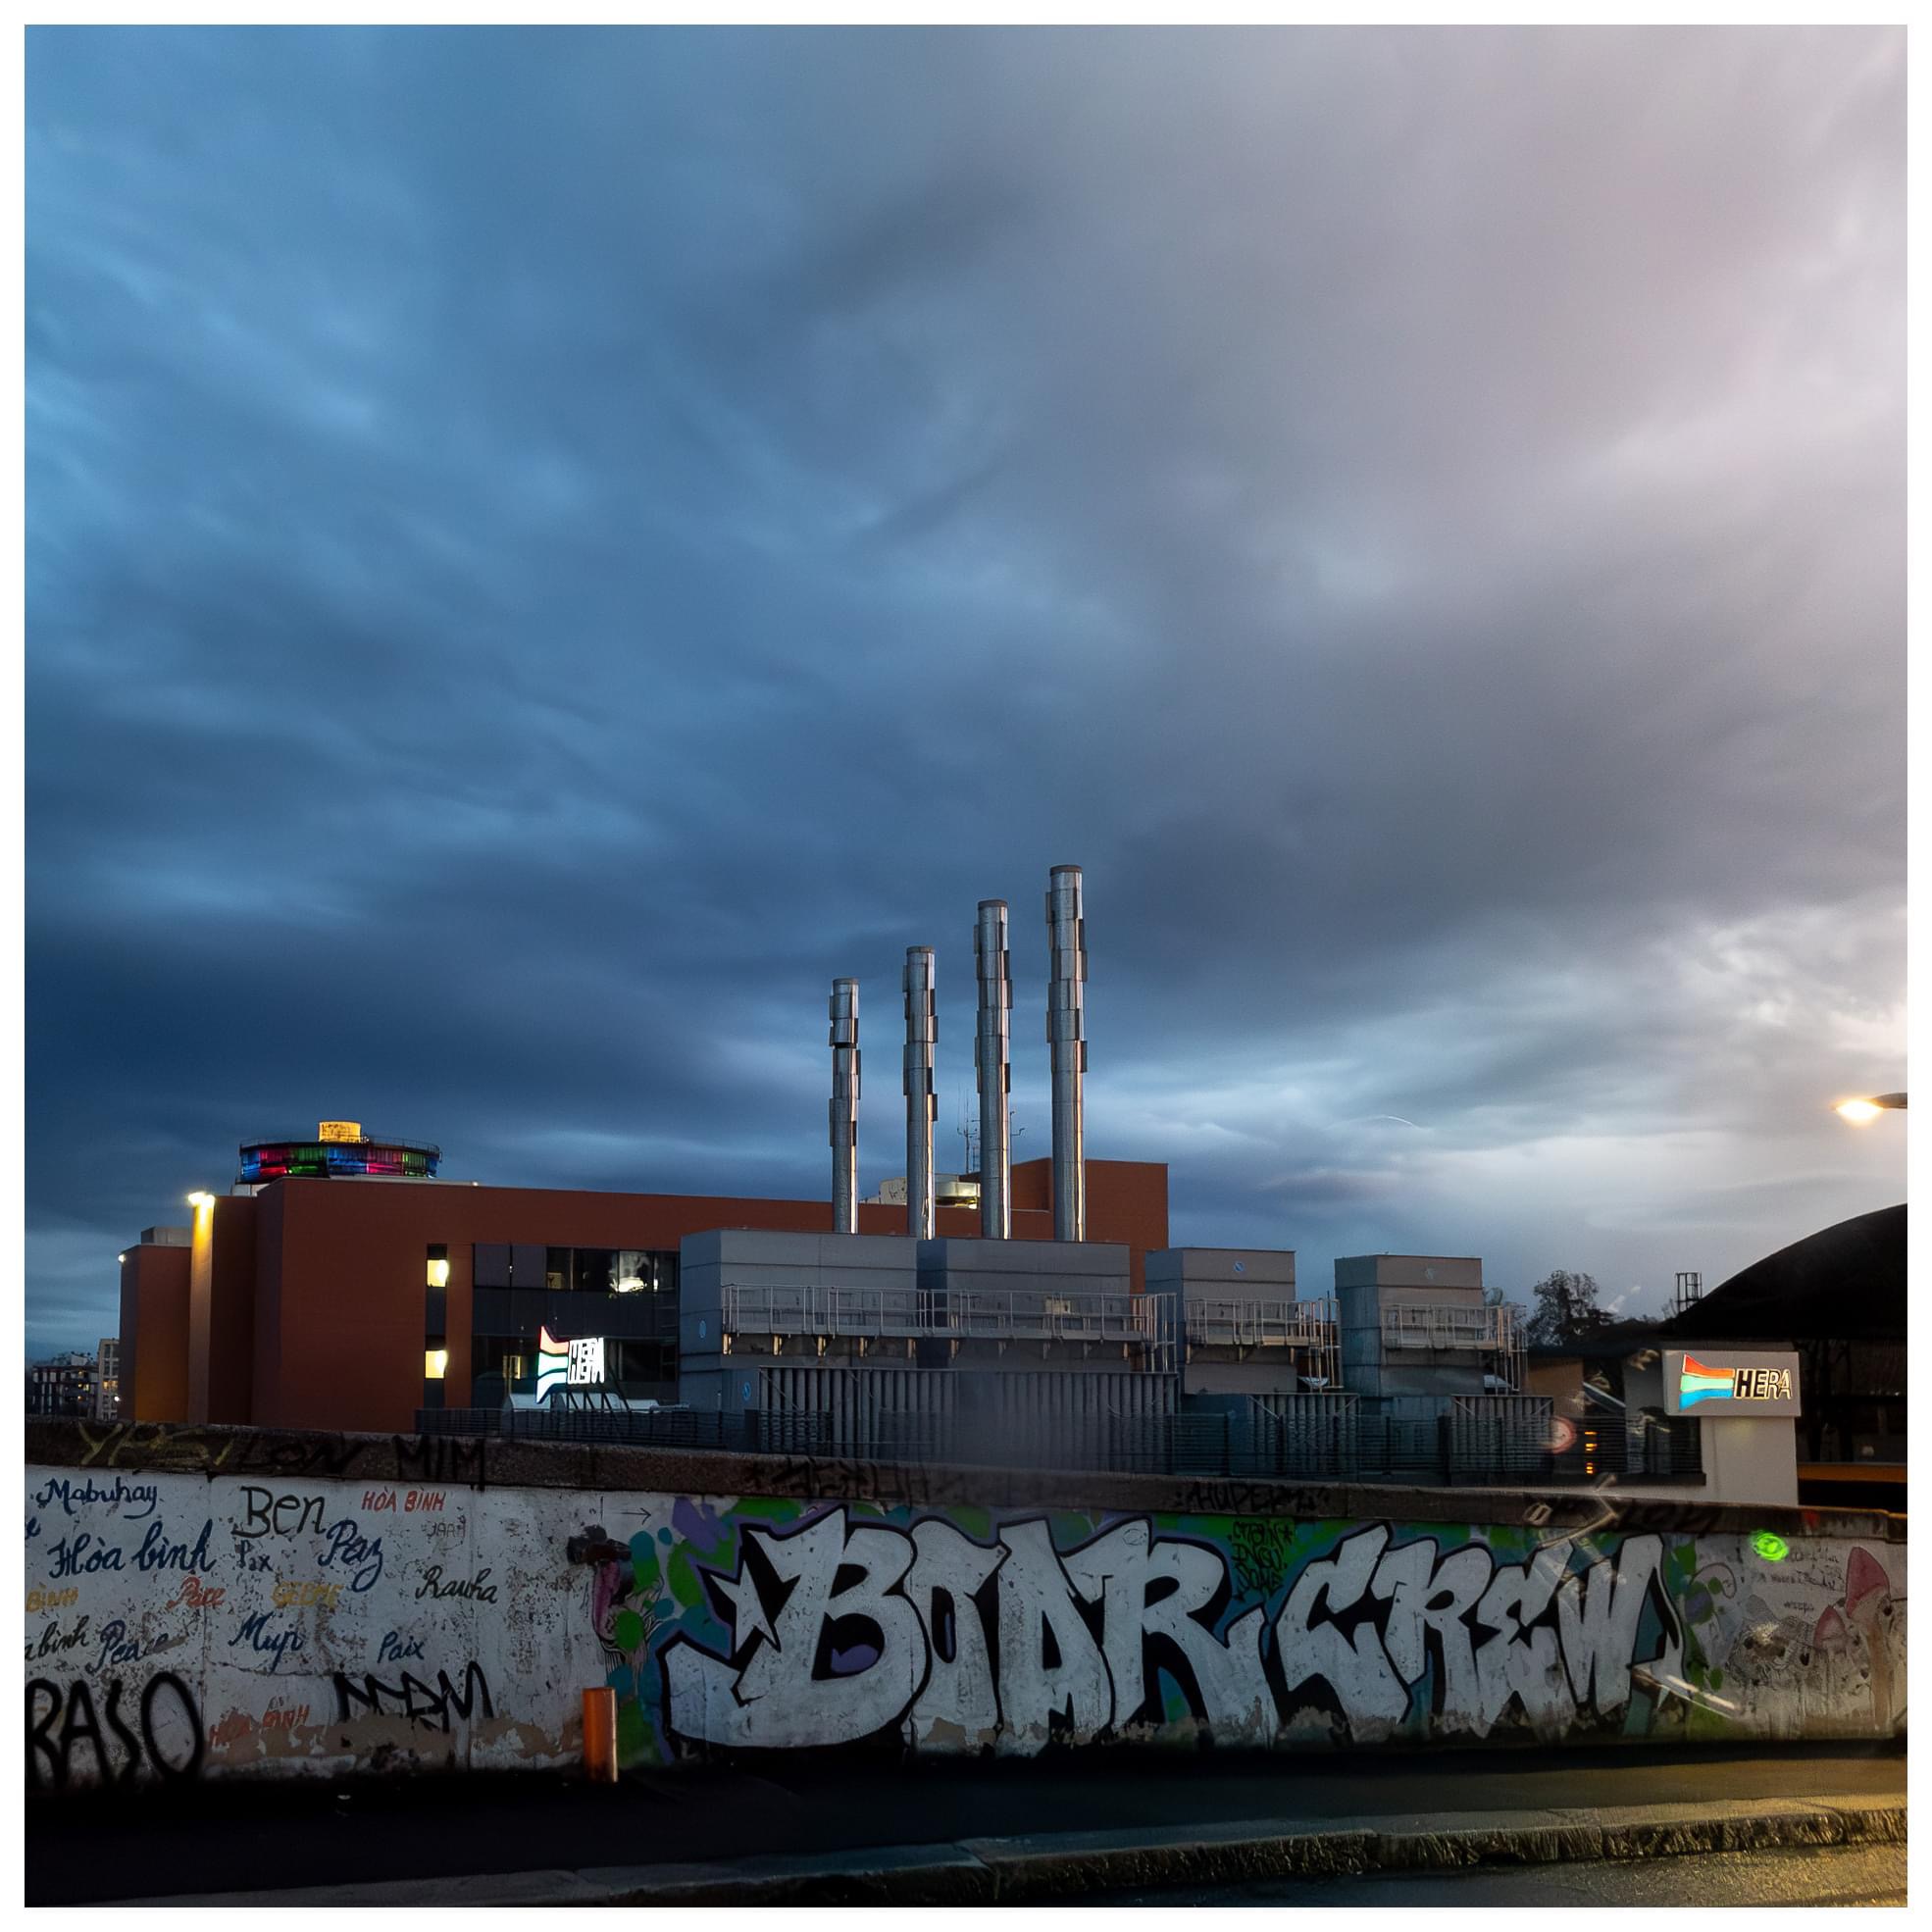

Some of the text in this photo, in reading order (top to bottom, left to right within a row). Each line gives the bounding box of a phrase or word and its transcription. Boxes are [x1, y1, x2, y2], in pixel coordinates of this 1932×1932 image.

[1733, 1368, 1794, 1400] HERA
[36, 1476, 159, 1519] Mabuhay
[231, 1485, 328, 1538] Ben
[361, 1484, 447, 1512] HÒA BÌNH
[47, 1518, 218, 1579] Hòa bình
[319, 1519, 383, 1593] Paz
[415, 1565, 498, 1604] Rauha
[88, 1619, 171, 1672] Peace
[377, 1631, 426, 1663] Paix
[657, 1506, 1683, 1755] BOAR CREW
